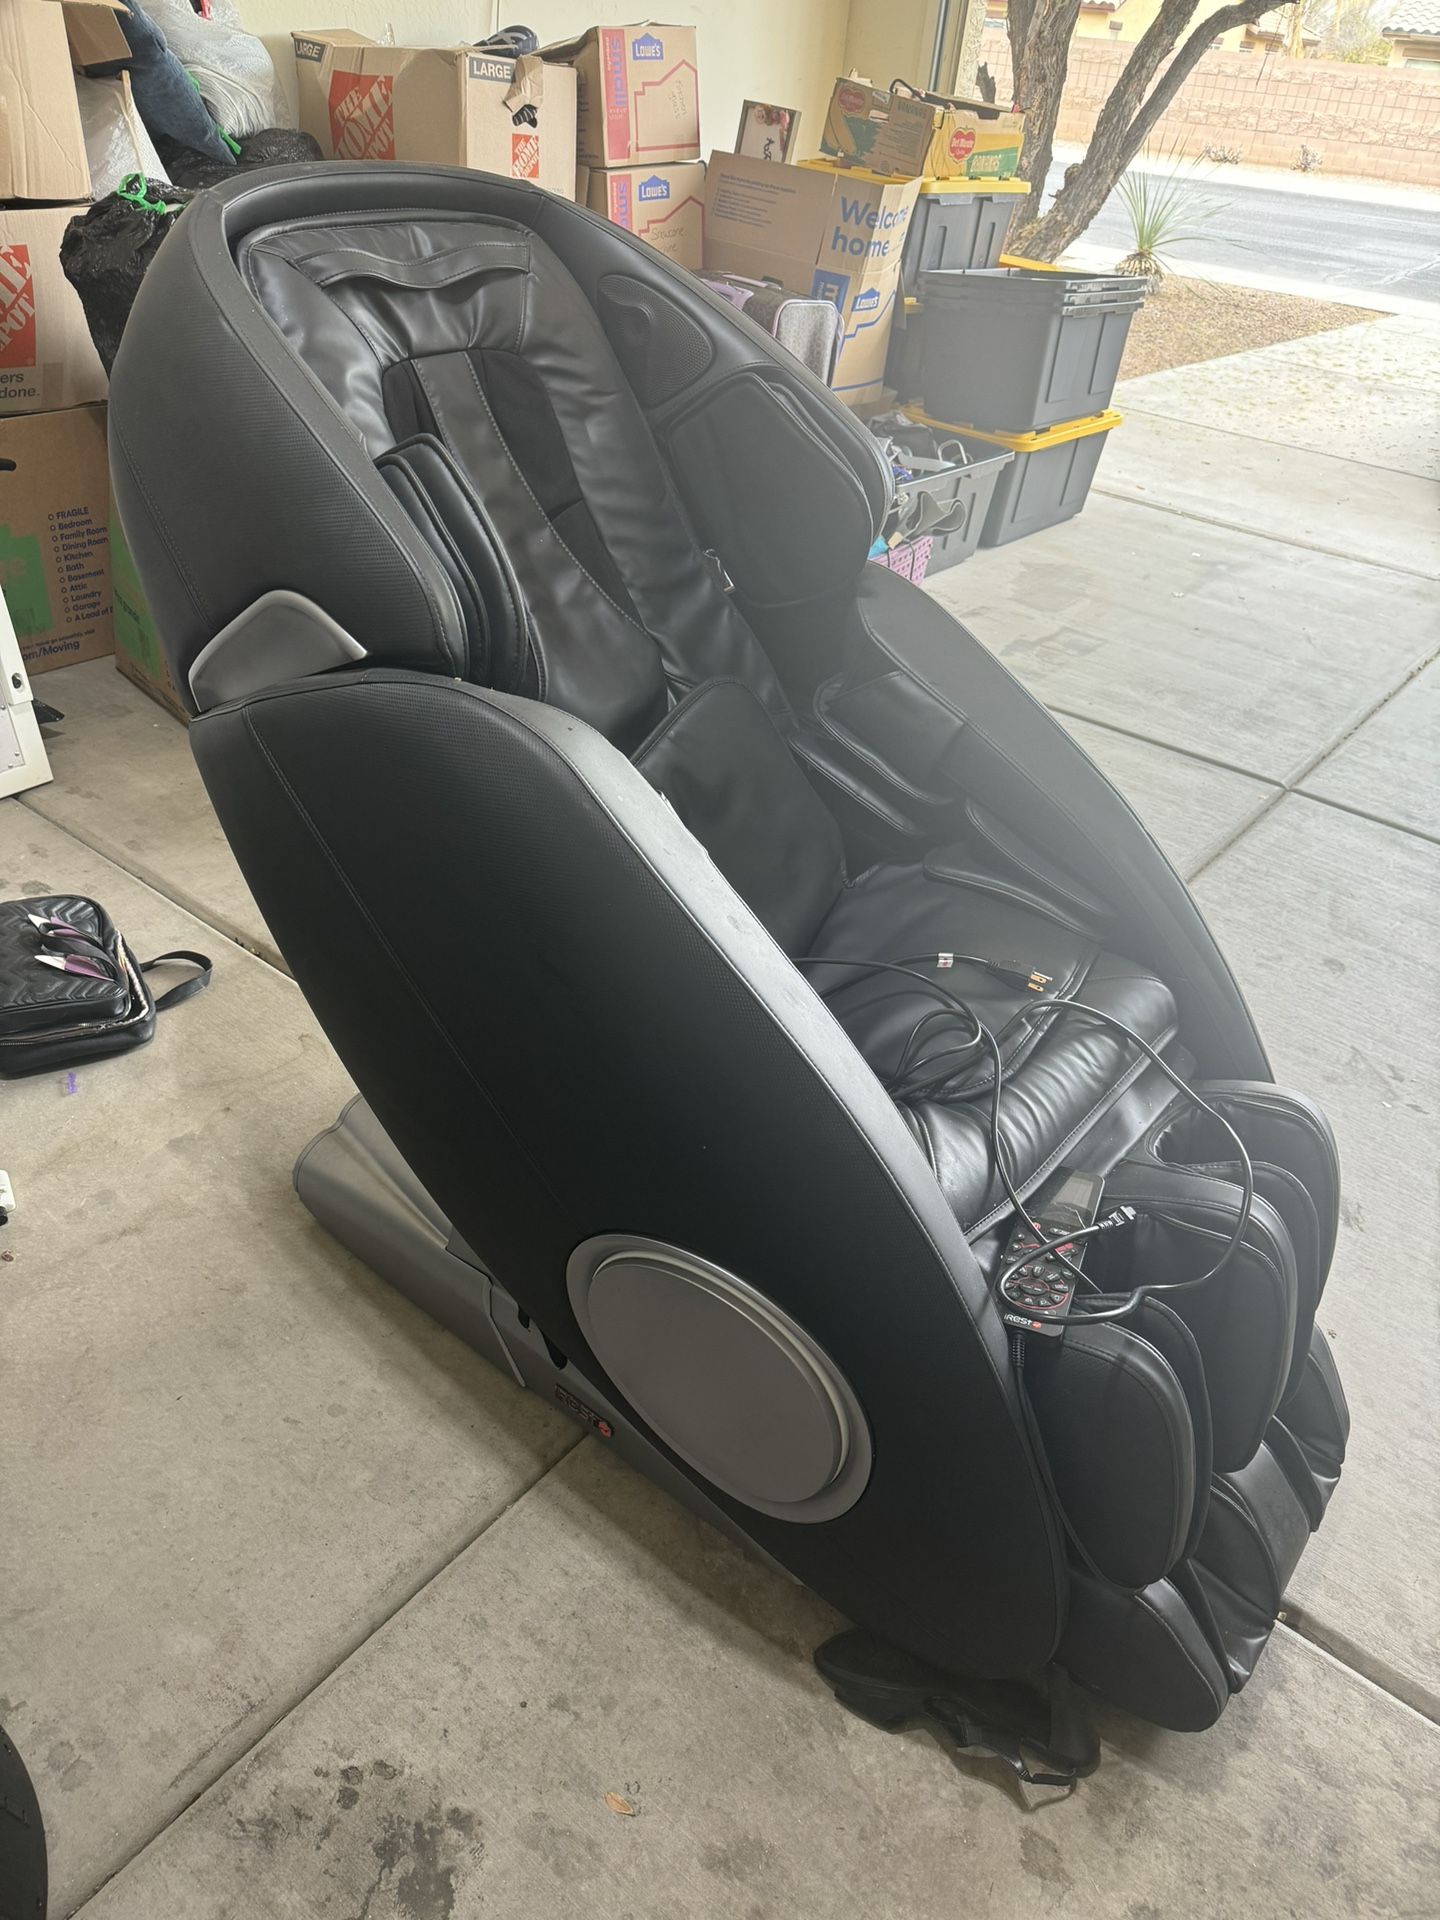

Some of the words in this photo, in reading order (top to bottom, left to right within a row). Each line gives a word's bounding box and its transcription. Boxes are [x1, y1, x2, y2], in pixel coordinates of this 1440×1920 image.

[295, 40, 321, 58] LARGE
[473, 60, 512, 79] LARGE
[832, 226, 890, 257] home
[56, 507, 89, 520] FRAGILE
[58, 519, 93, 530] Bedroom
[60, 531, 86, 542] Family
[86, 526, 107, 537] Room
[62, 541, 87, 552] Dining
[64, 551, 93, 562] Kitchen
[66, 563, 85, 572] Bath
[68, 569, 104, 582] Basement
[69, 583, 88, 593] Attic
[71, 591, 102, 602] Laundry
[73, 602, 101, 612] Garage
